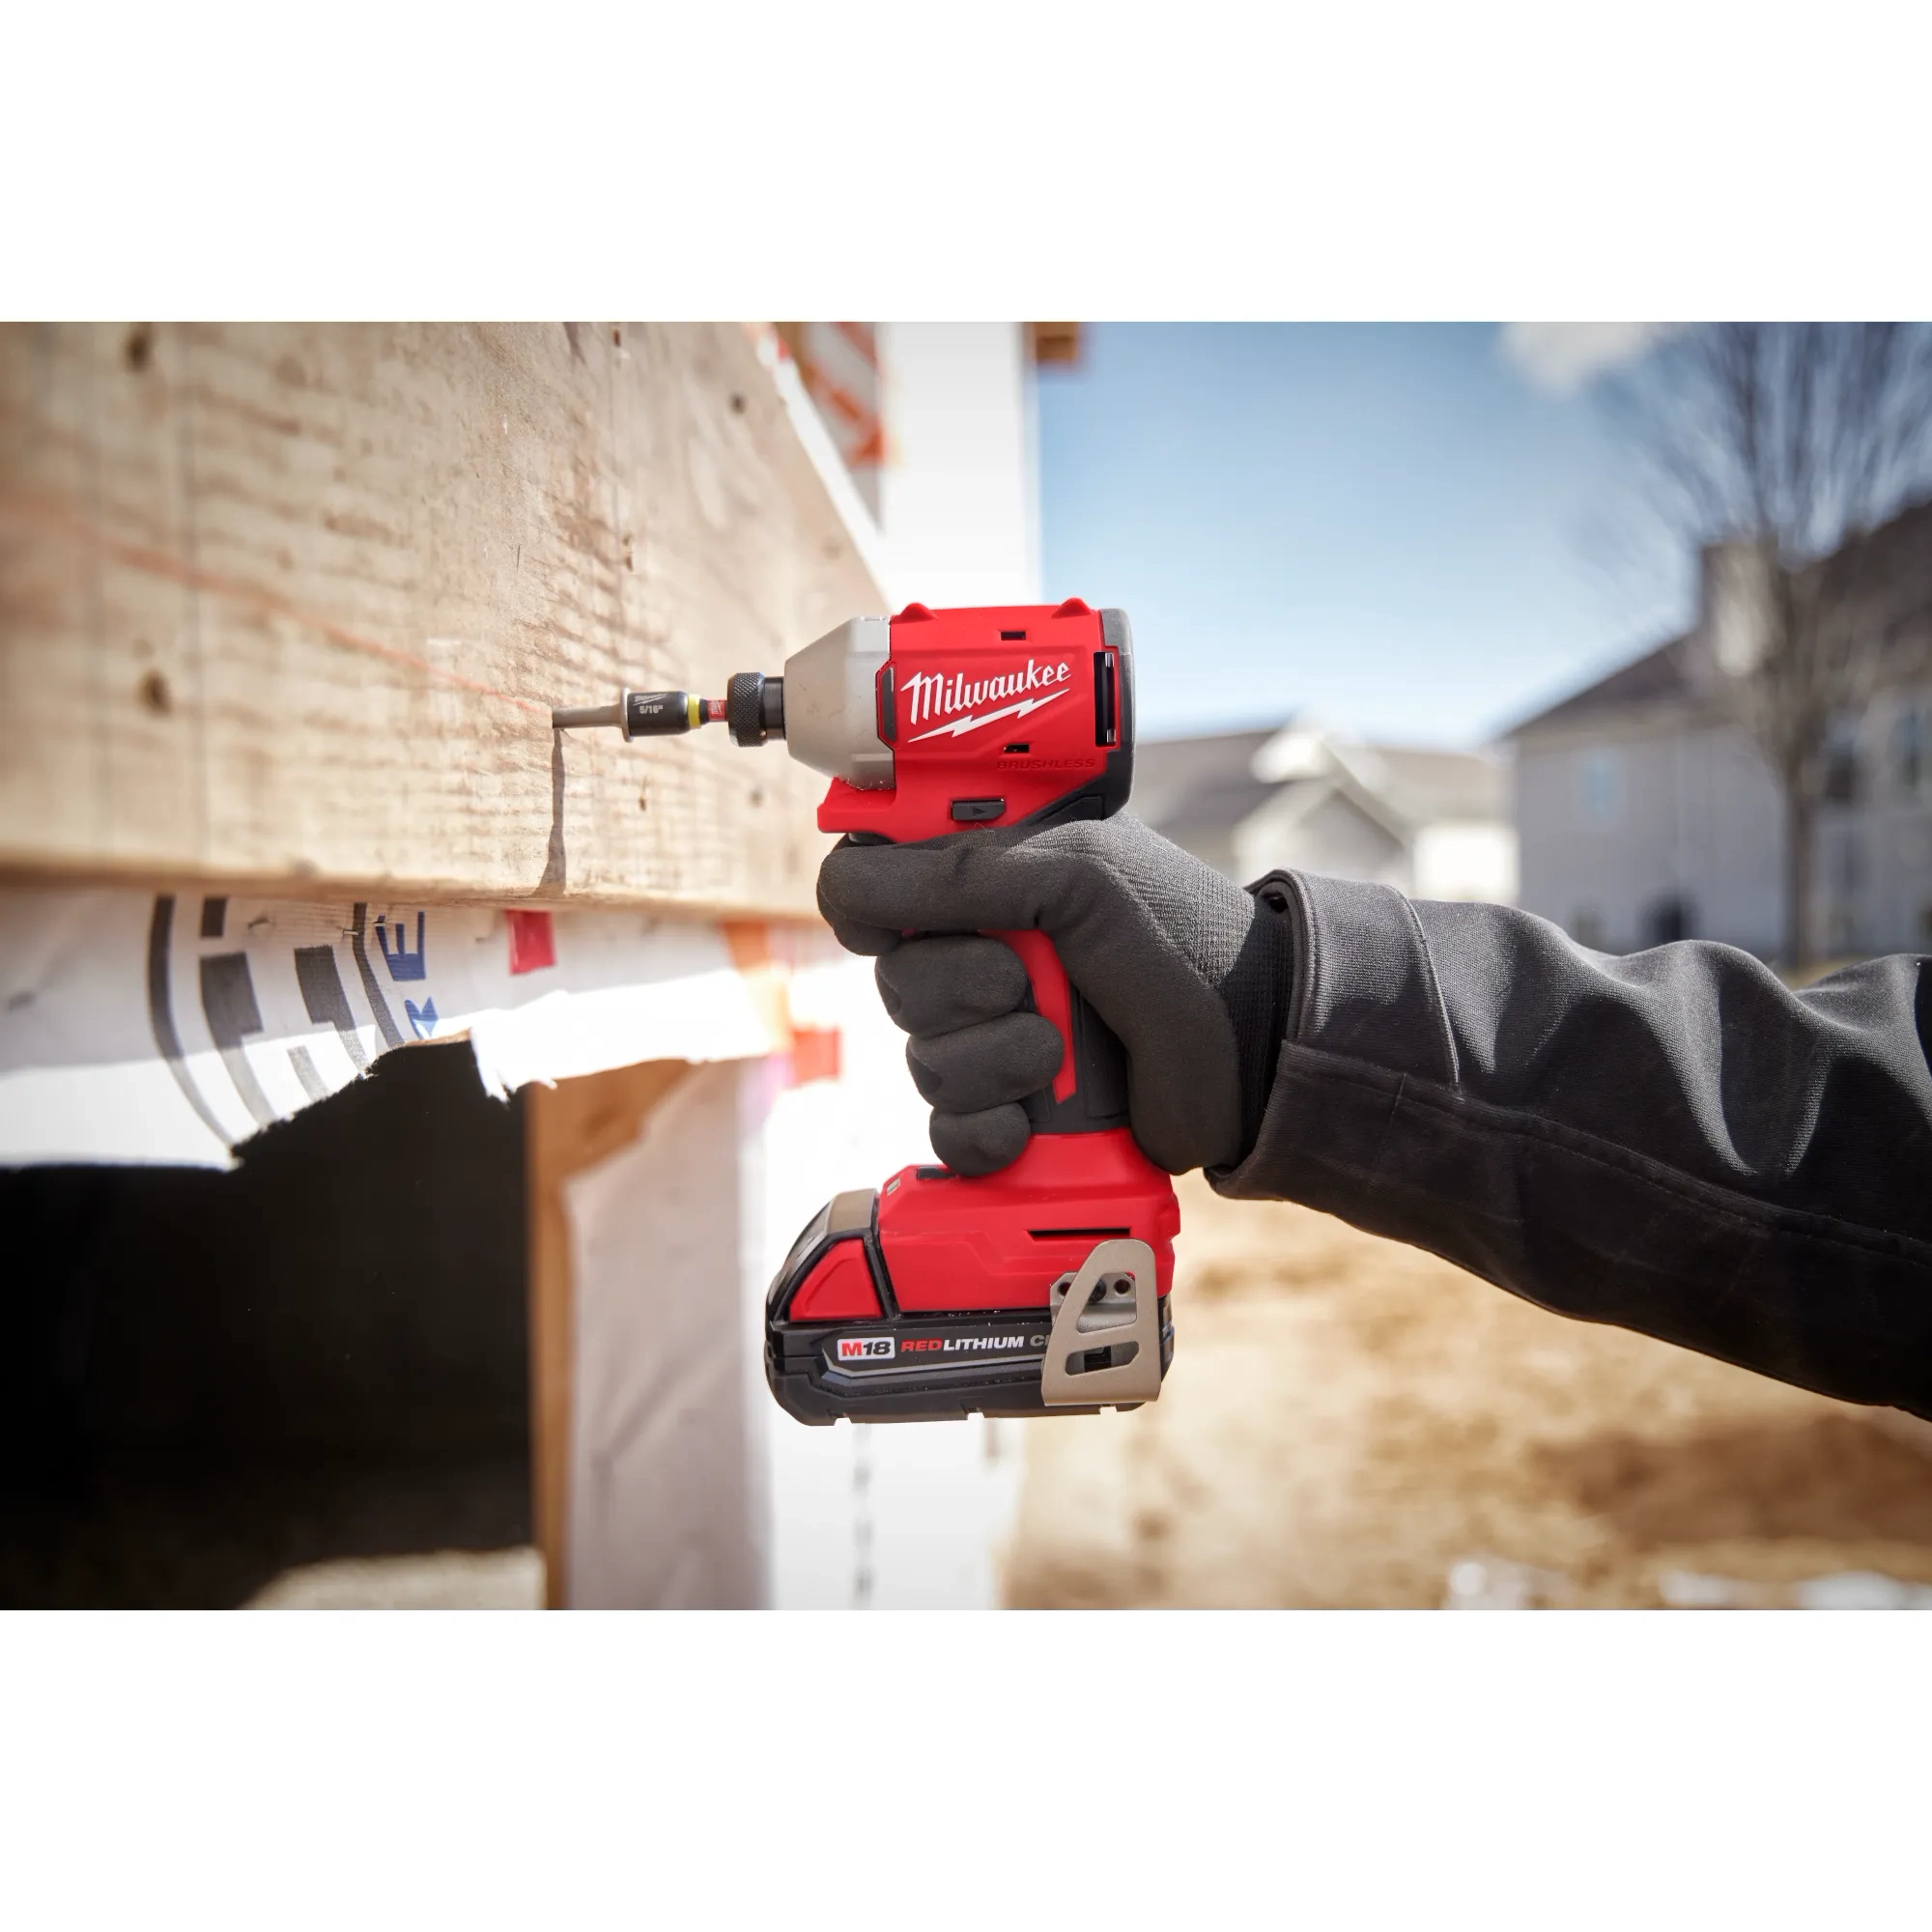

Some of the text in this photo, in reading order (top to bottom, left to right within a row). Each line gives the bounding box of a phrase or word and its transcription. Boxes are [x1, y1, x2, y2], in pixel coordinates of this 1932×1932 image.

[900, 659, 1071, 725] Milwaukee
[639, 704, 665, 715] 5/16"
[995, 757, 1096, 771] BRUSHLESS
[840, 1341, 893, 1357] M18
[900, 1336, 1025, 1352] REDLITHIUM
